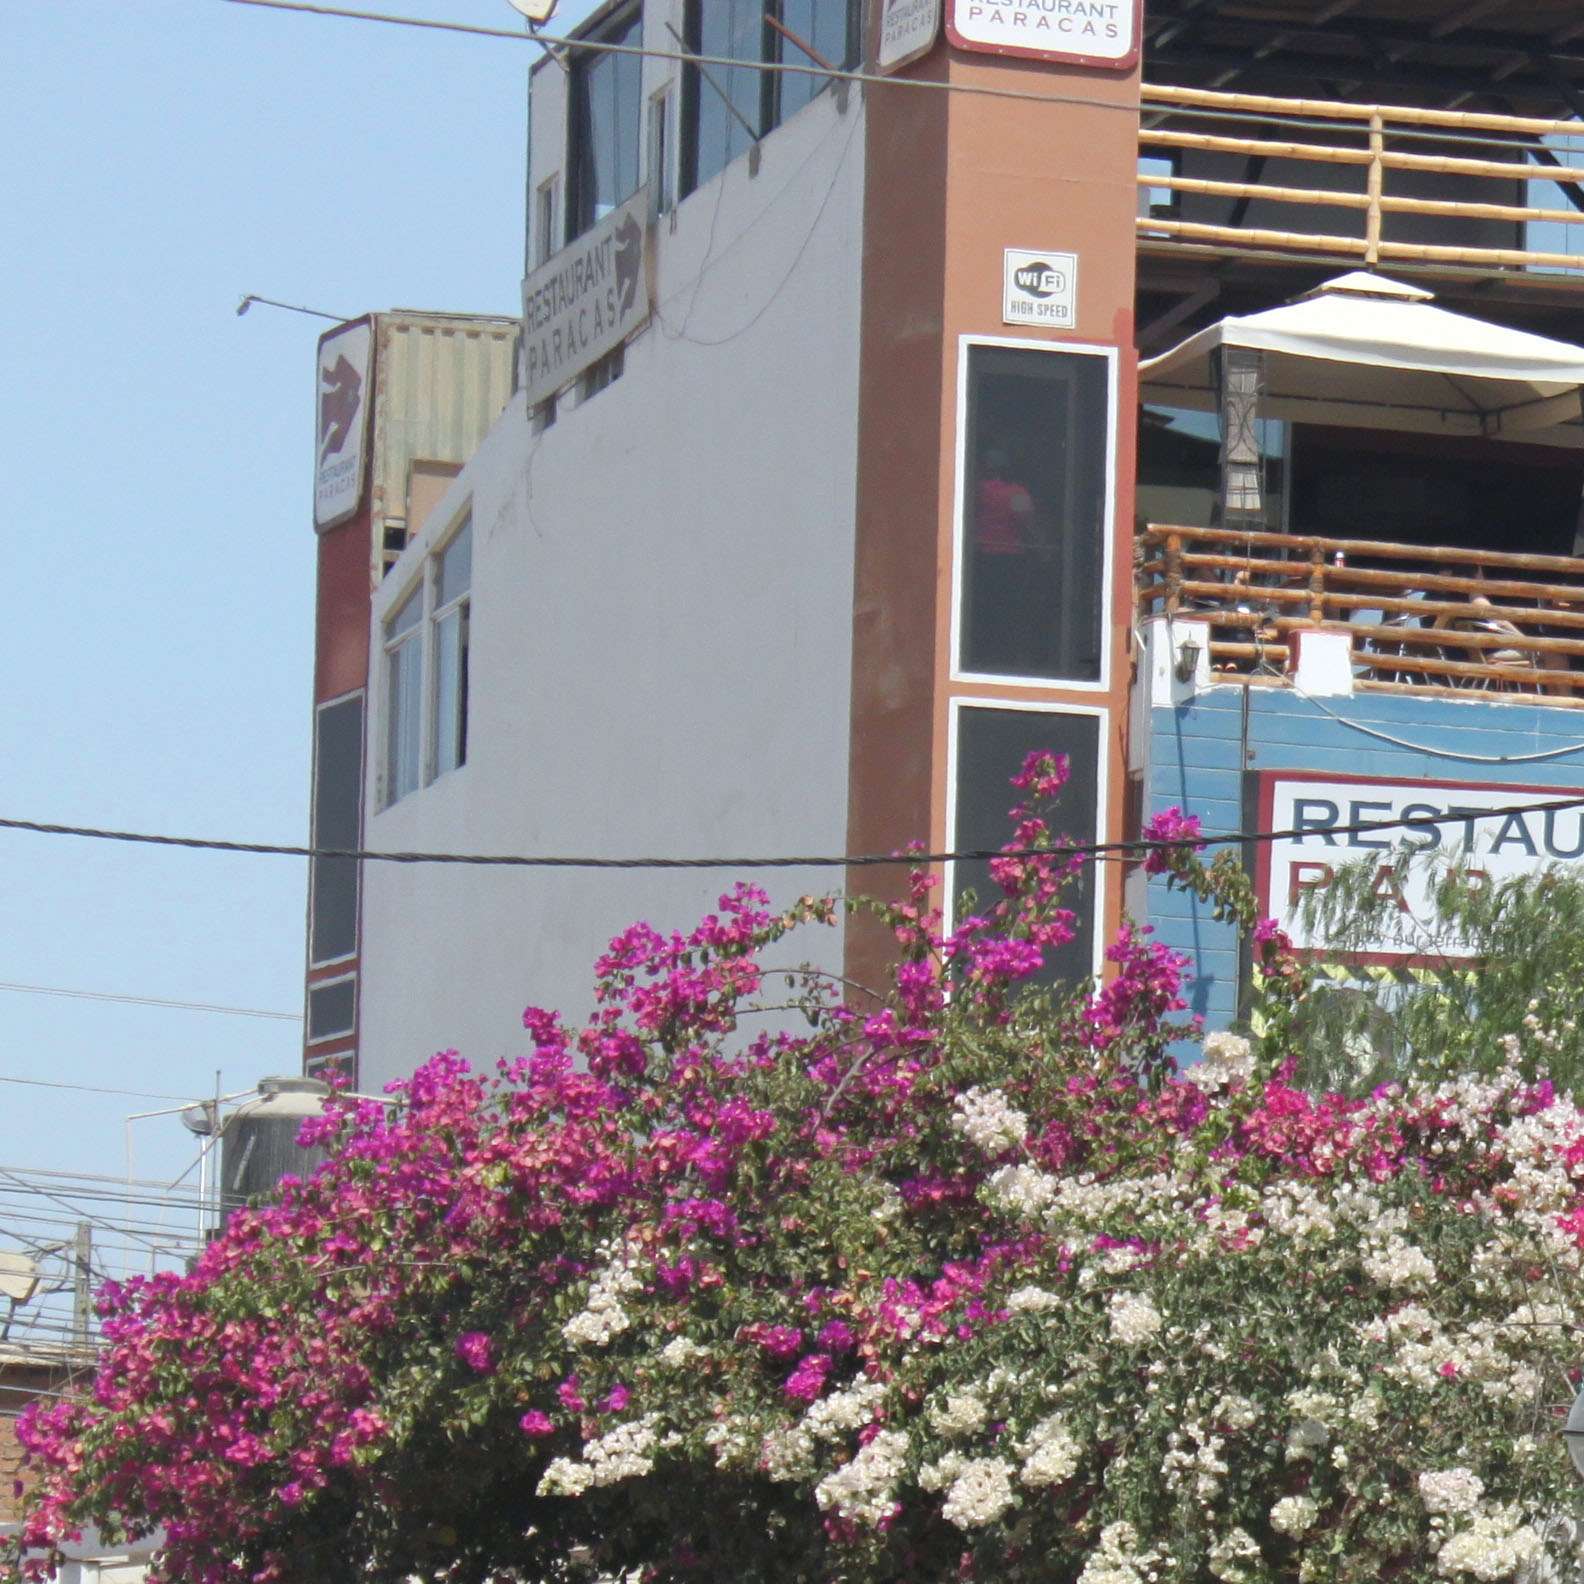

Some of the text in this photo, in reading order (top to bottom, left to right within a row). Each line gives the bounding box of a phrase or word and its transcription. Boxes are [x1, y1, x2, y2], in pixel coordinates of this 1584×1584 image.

[969, 6, 1118, 38] PARACAS
[527, 235, 613, 332] RESTAURANT
[1010, 300, 1068, 318] HIGH SPEED
[527, 287, 615, 382] PARACAS
